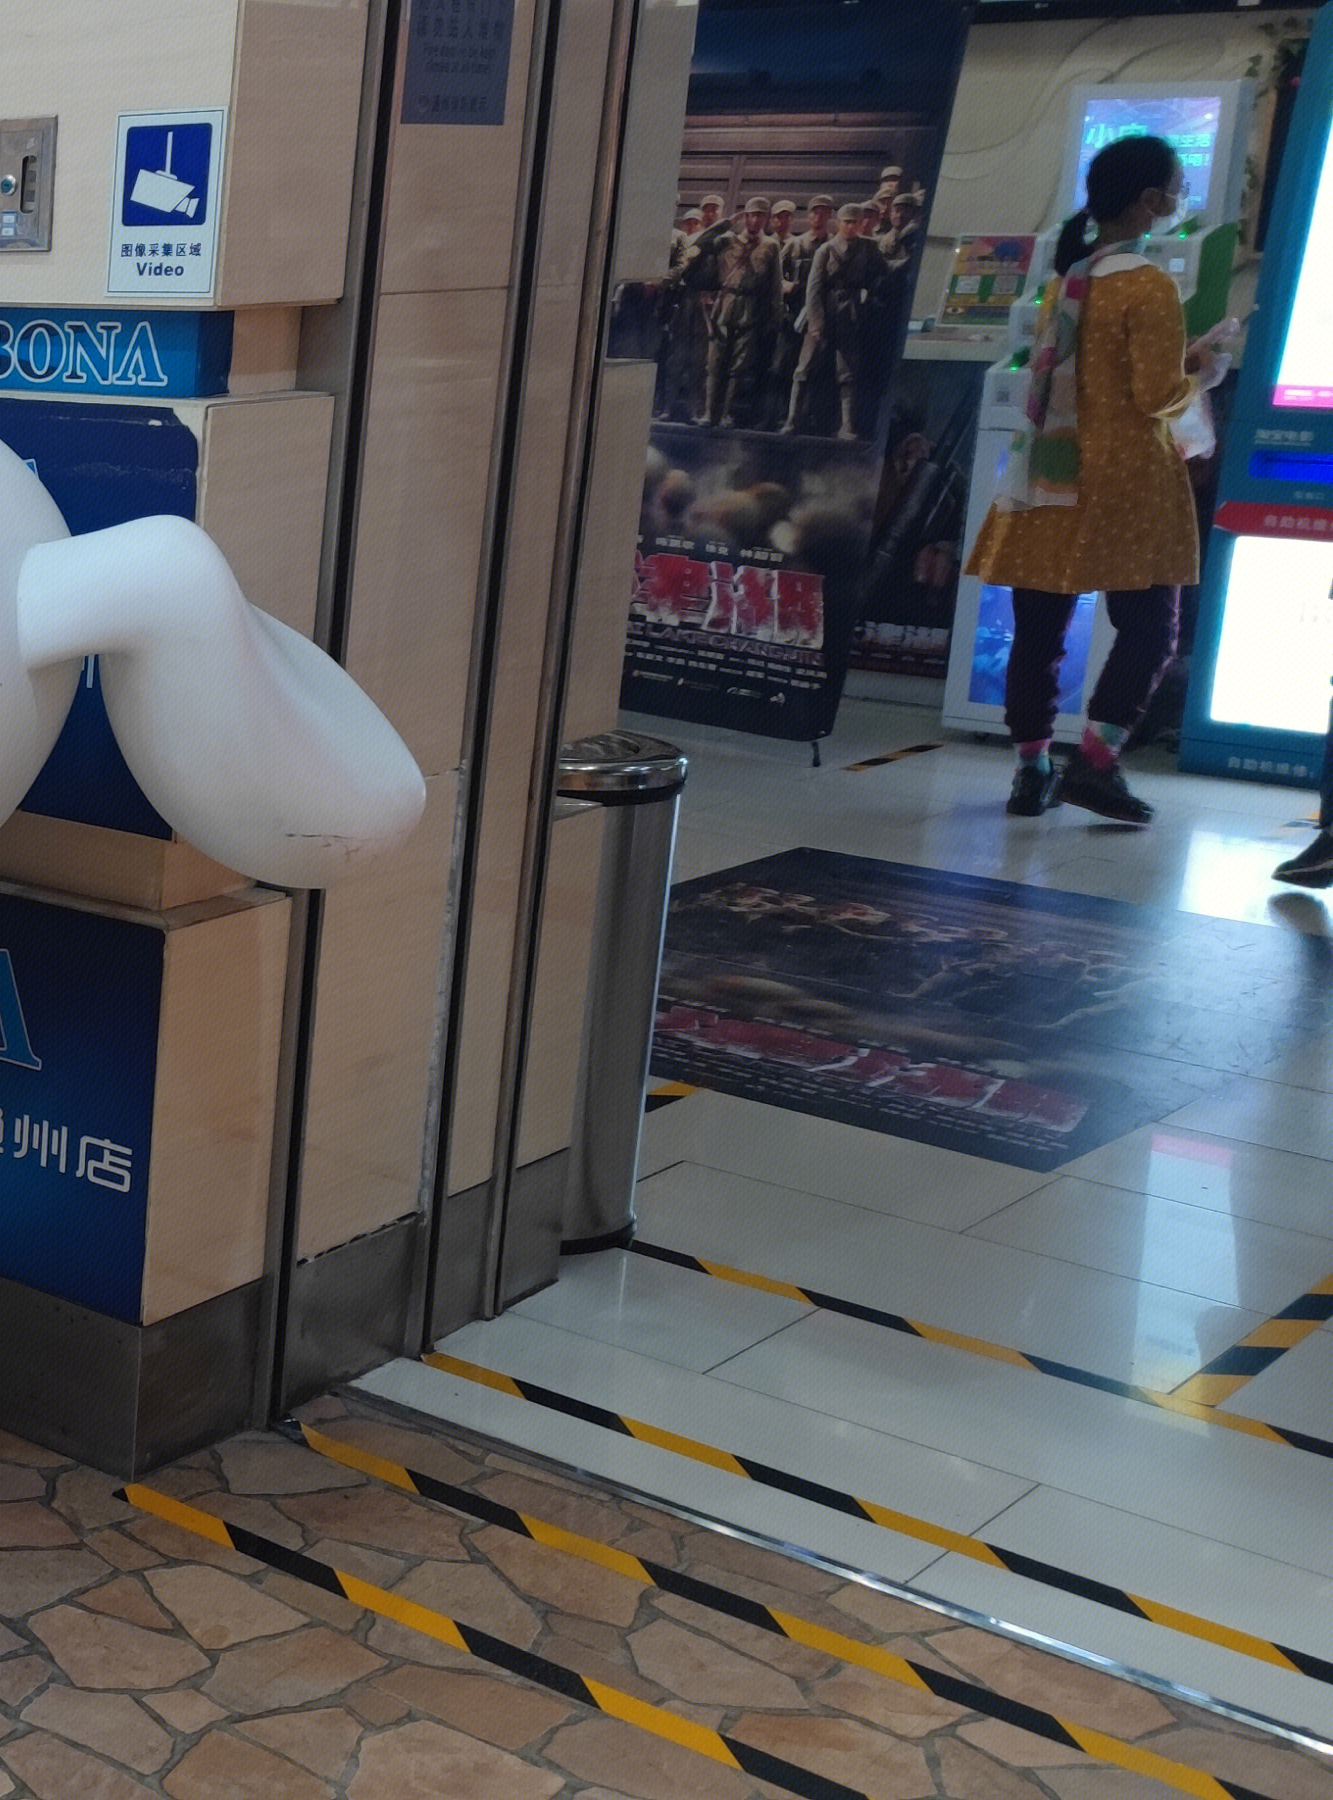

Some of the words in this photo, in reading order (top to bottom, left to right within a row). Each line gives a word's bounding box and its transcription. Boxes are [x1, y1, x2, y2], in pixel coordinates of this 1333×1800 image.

[120, 243, 202, 257] 图像采集区域
[136, 262, 184, 276] Video
